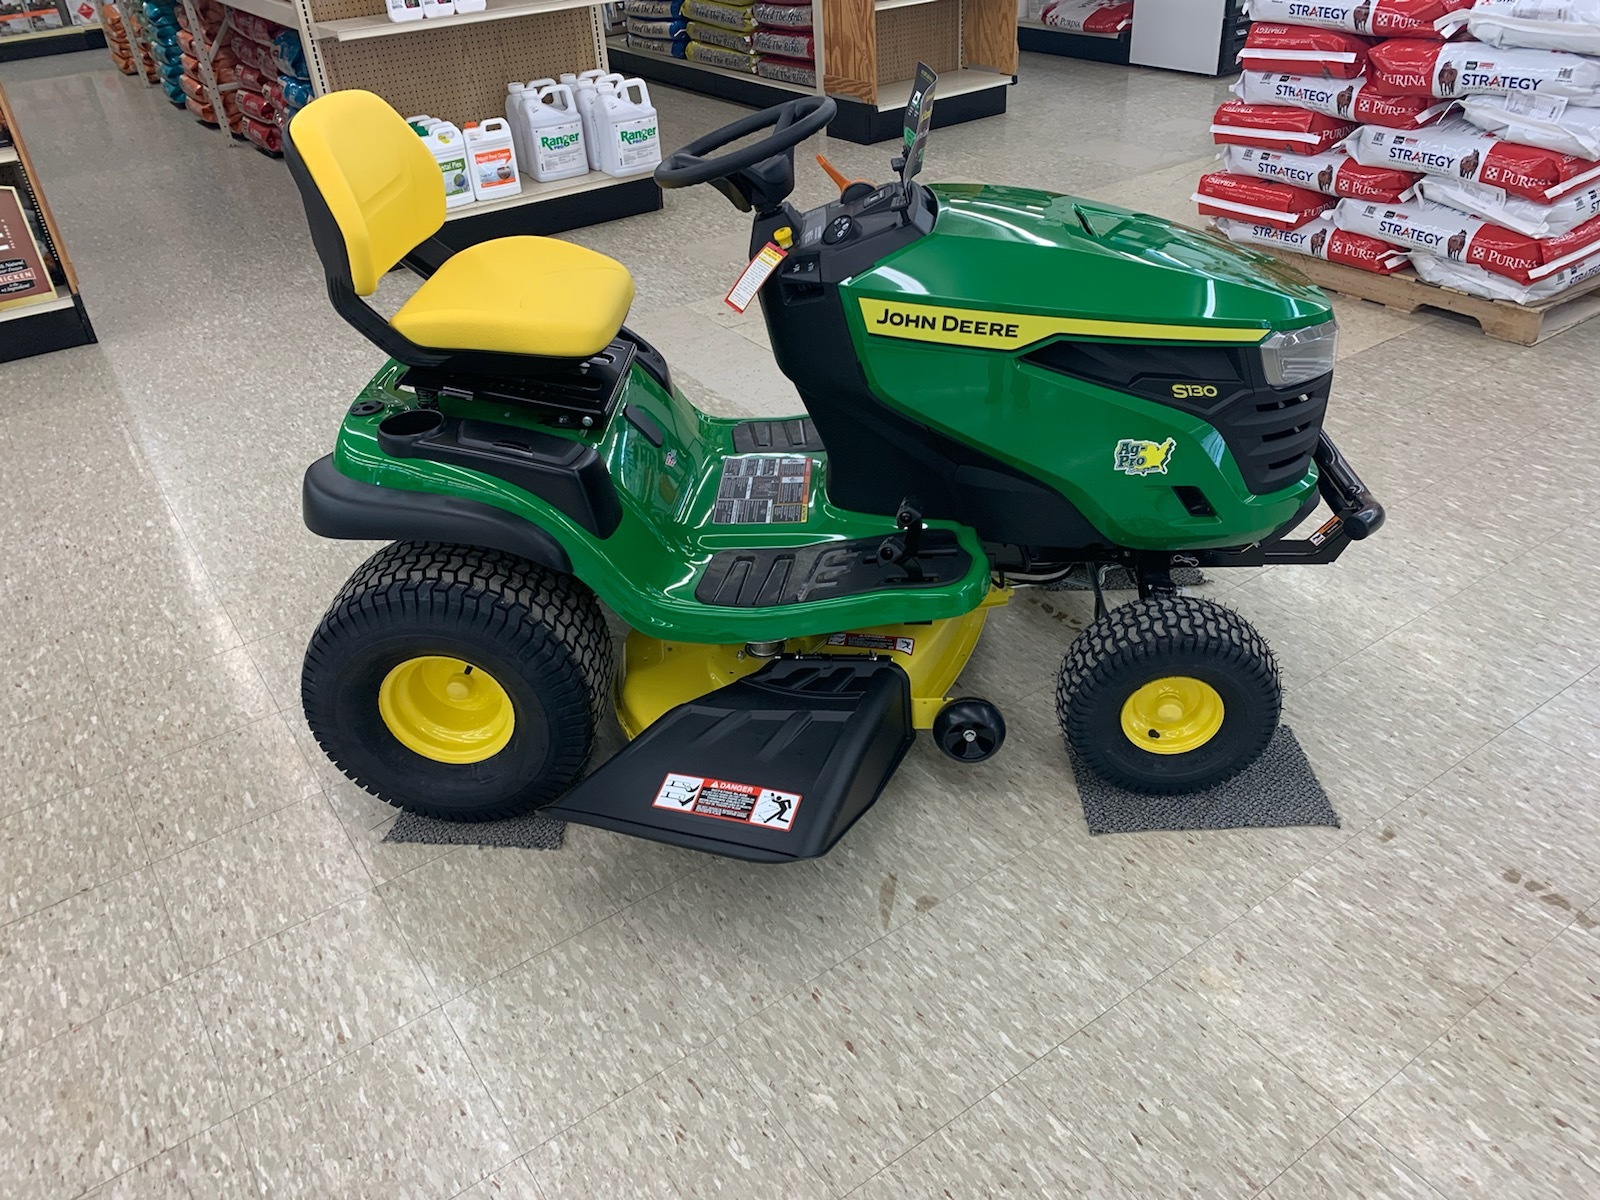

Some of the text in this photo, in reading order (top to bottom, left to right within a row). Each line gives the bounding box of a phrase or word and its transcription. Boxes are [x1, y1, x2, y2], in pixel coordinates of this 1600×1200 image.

[1289, 4, 1349, 20] STRATEGY
[1462, 73, 1542, 91] STRATEGY
[1275, 85, 1333, 103] STRATEGY
[541, 132, 579, 150] Ranger
[621, 127, 657, 145] Ranger
[1389, 147, 1455, 169] STRATEGY
[1258, 162, 1314, 182] STRATEGY
[1252, 225, 1307, 244] STRATEGY
[1379, 221, 1444, 246] STRATEGY
[876, 308, 1019, 338] JOHN DEERE
[1171, 384, 1218, 399] S130
[1119, 442, 1146, 457] Ag-
[1119, 456, 1145, 468] Pro
[720, 782, 754, 793] DANGER
